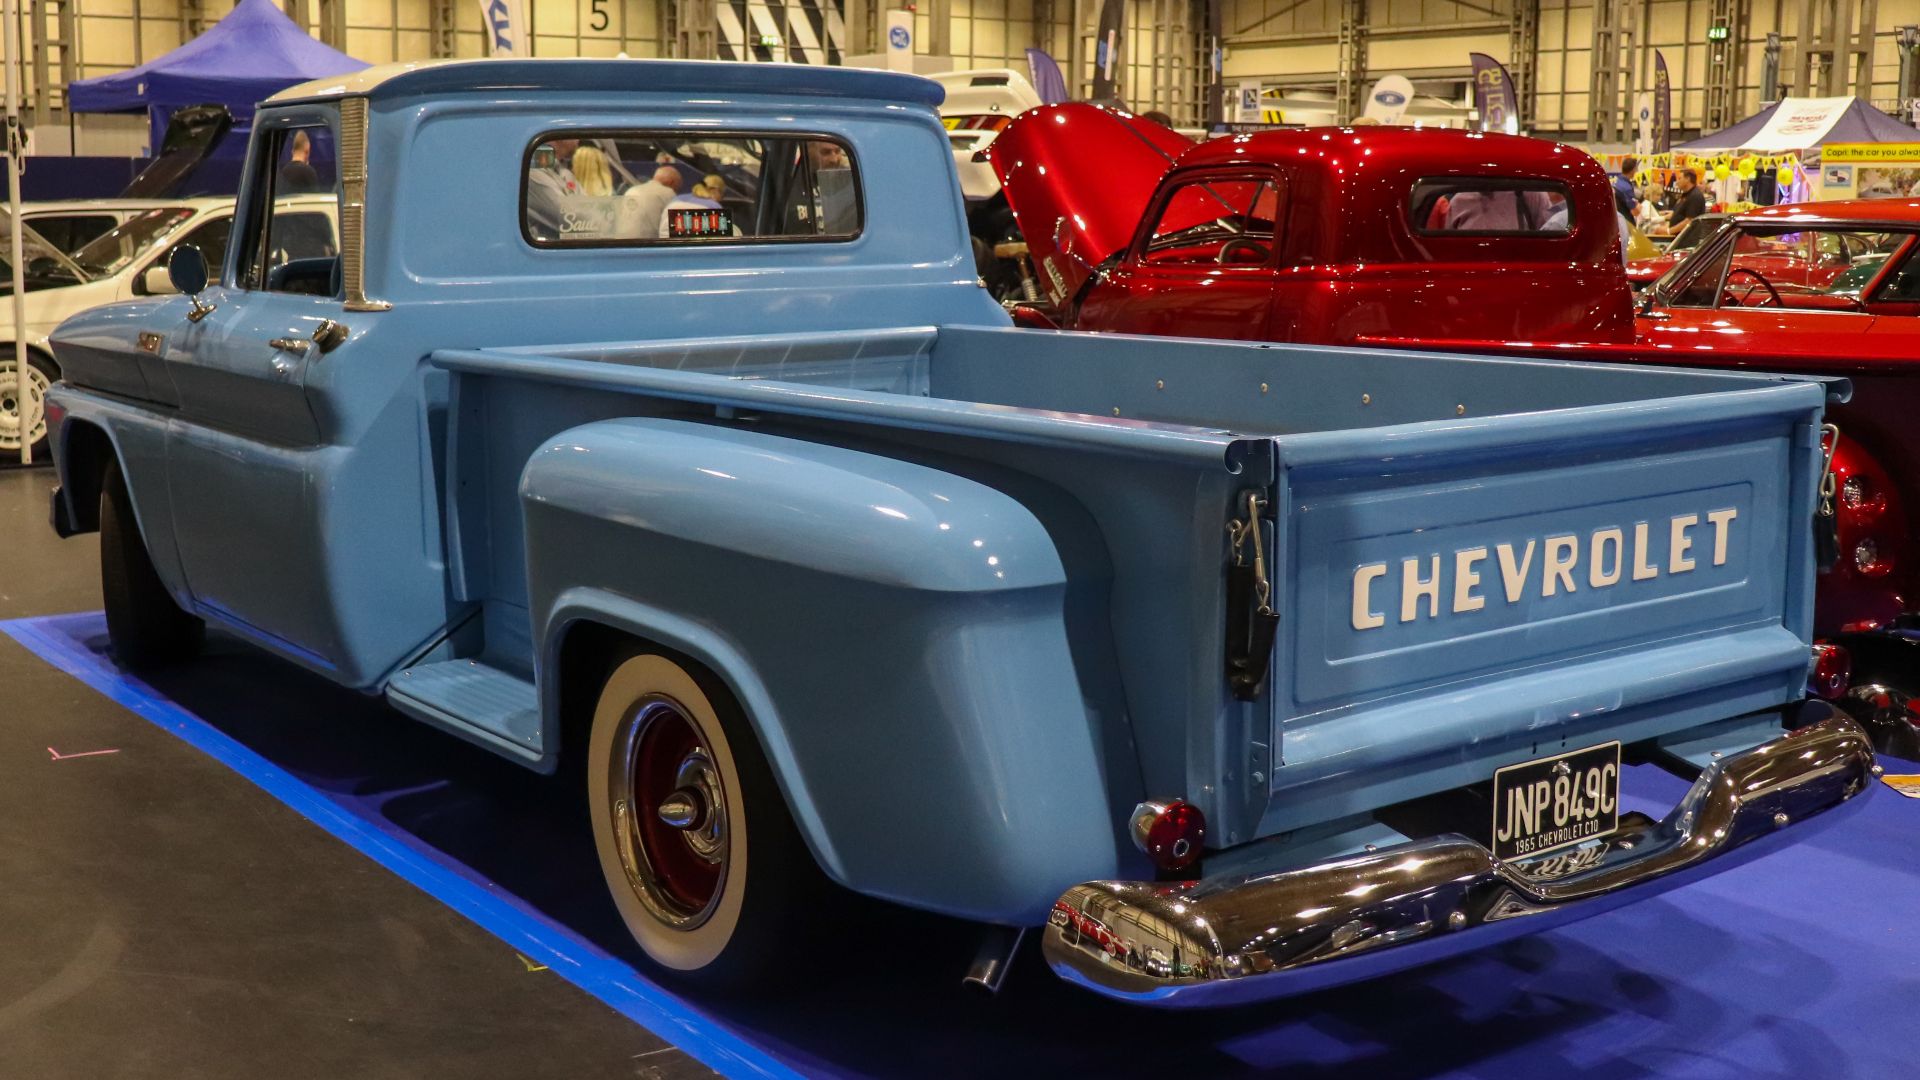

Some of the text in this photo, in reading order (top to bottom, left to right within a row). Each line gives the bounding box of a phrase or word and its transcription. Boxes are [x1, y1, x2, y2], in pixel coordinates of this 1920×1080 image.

[590, 0, 609, 31] 5
[1851, 148, 1863, 156] the
[1882, 149, 1897, 157] you
[1899, 148, 1920, 156] alwa
[675, 214, 727, 230] ATOMIC
[1351, 508, 1738, 630] CHEVROLET
[1497, 763, 1616, 842] JNP 849C
[1516, 819, 1599, 855] 1965 CHEVROLET C10
